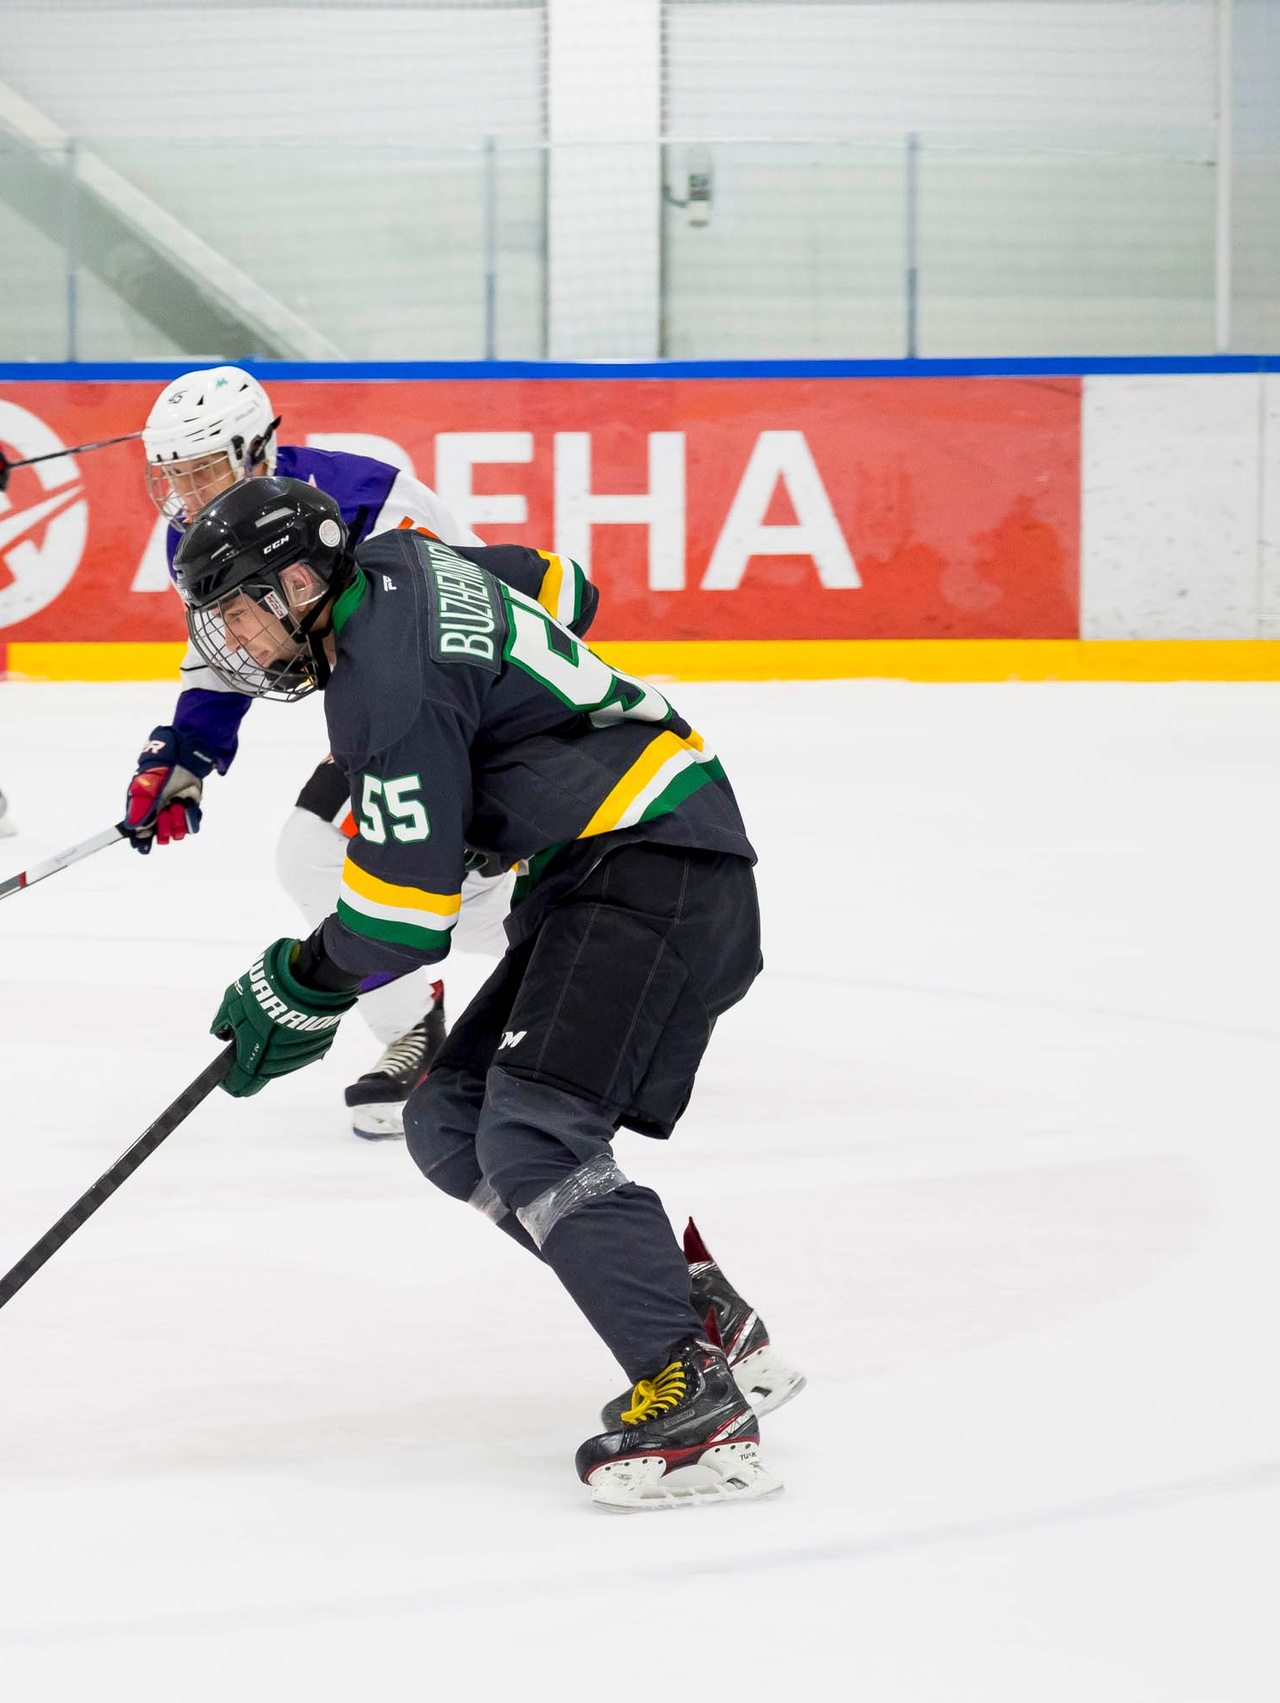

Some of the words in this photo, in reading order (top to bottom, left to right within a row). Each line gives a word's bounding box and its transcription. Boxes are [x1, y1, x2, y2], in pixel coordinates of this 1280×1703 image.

[131, 430, 863, 593] ЕНА
[263, 534, 290, 555] CCM
[359, 773, 431, 845] 55
